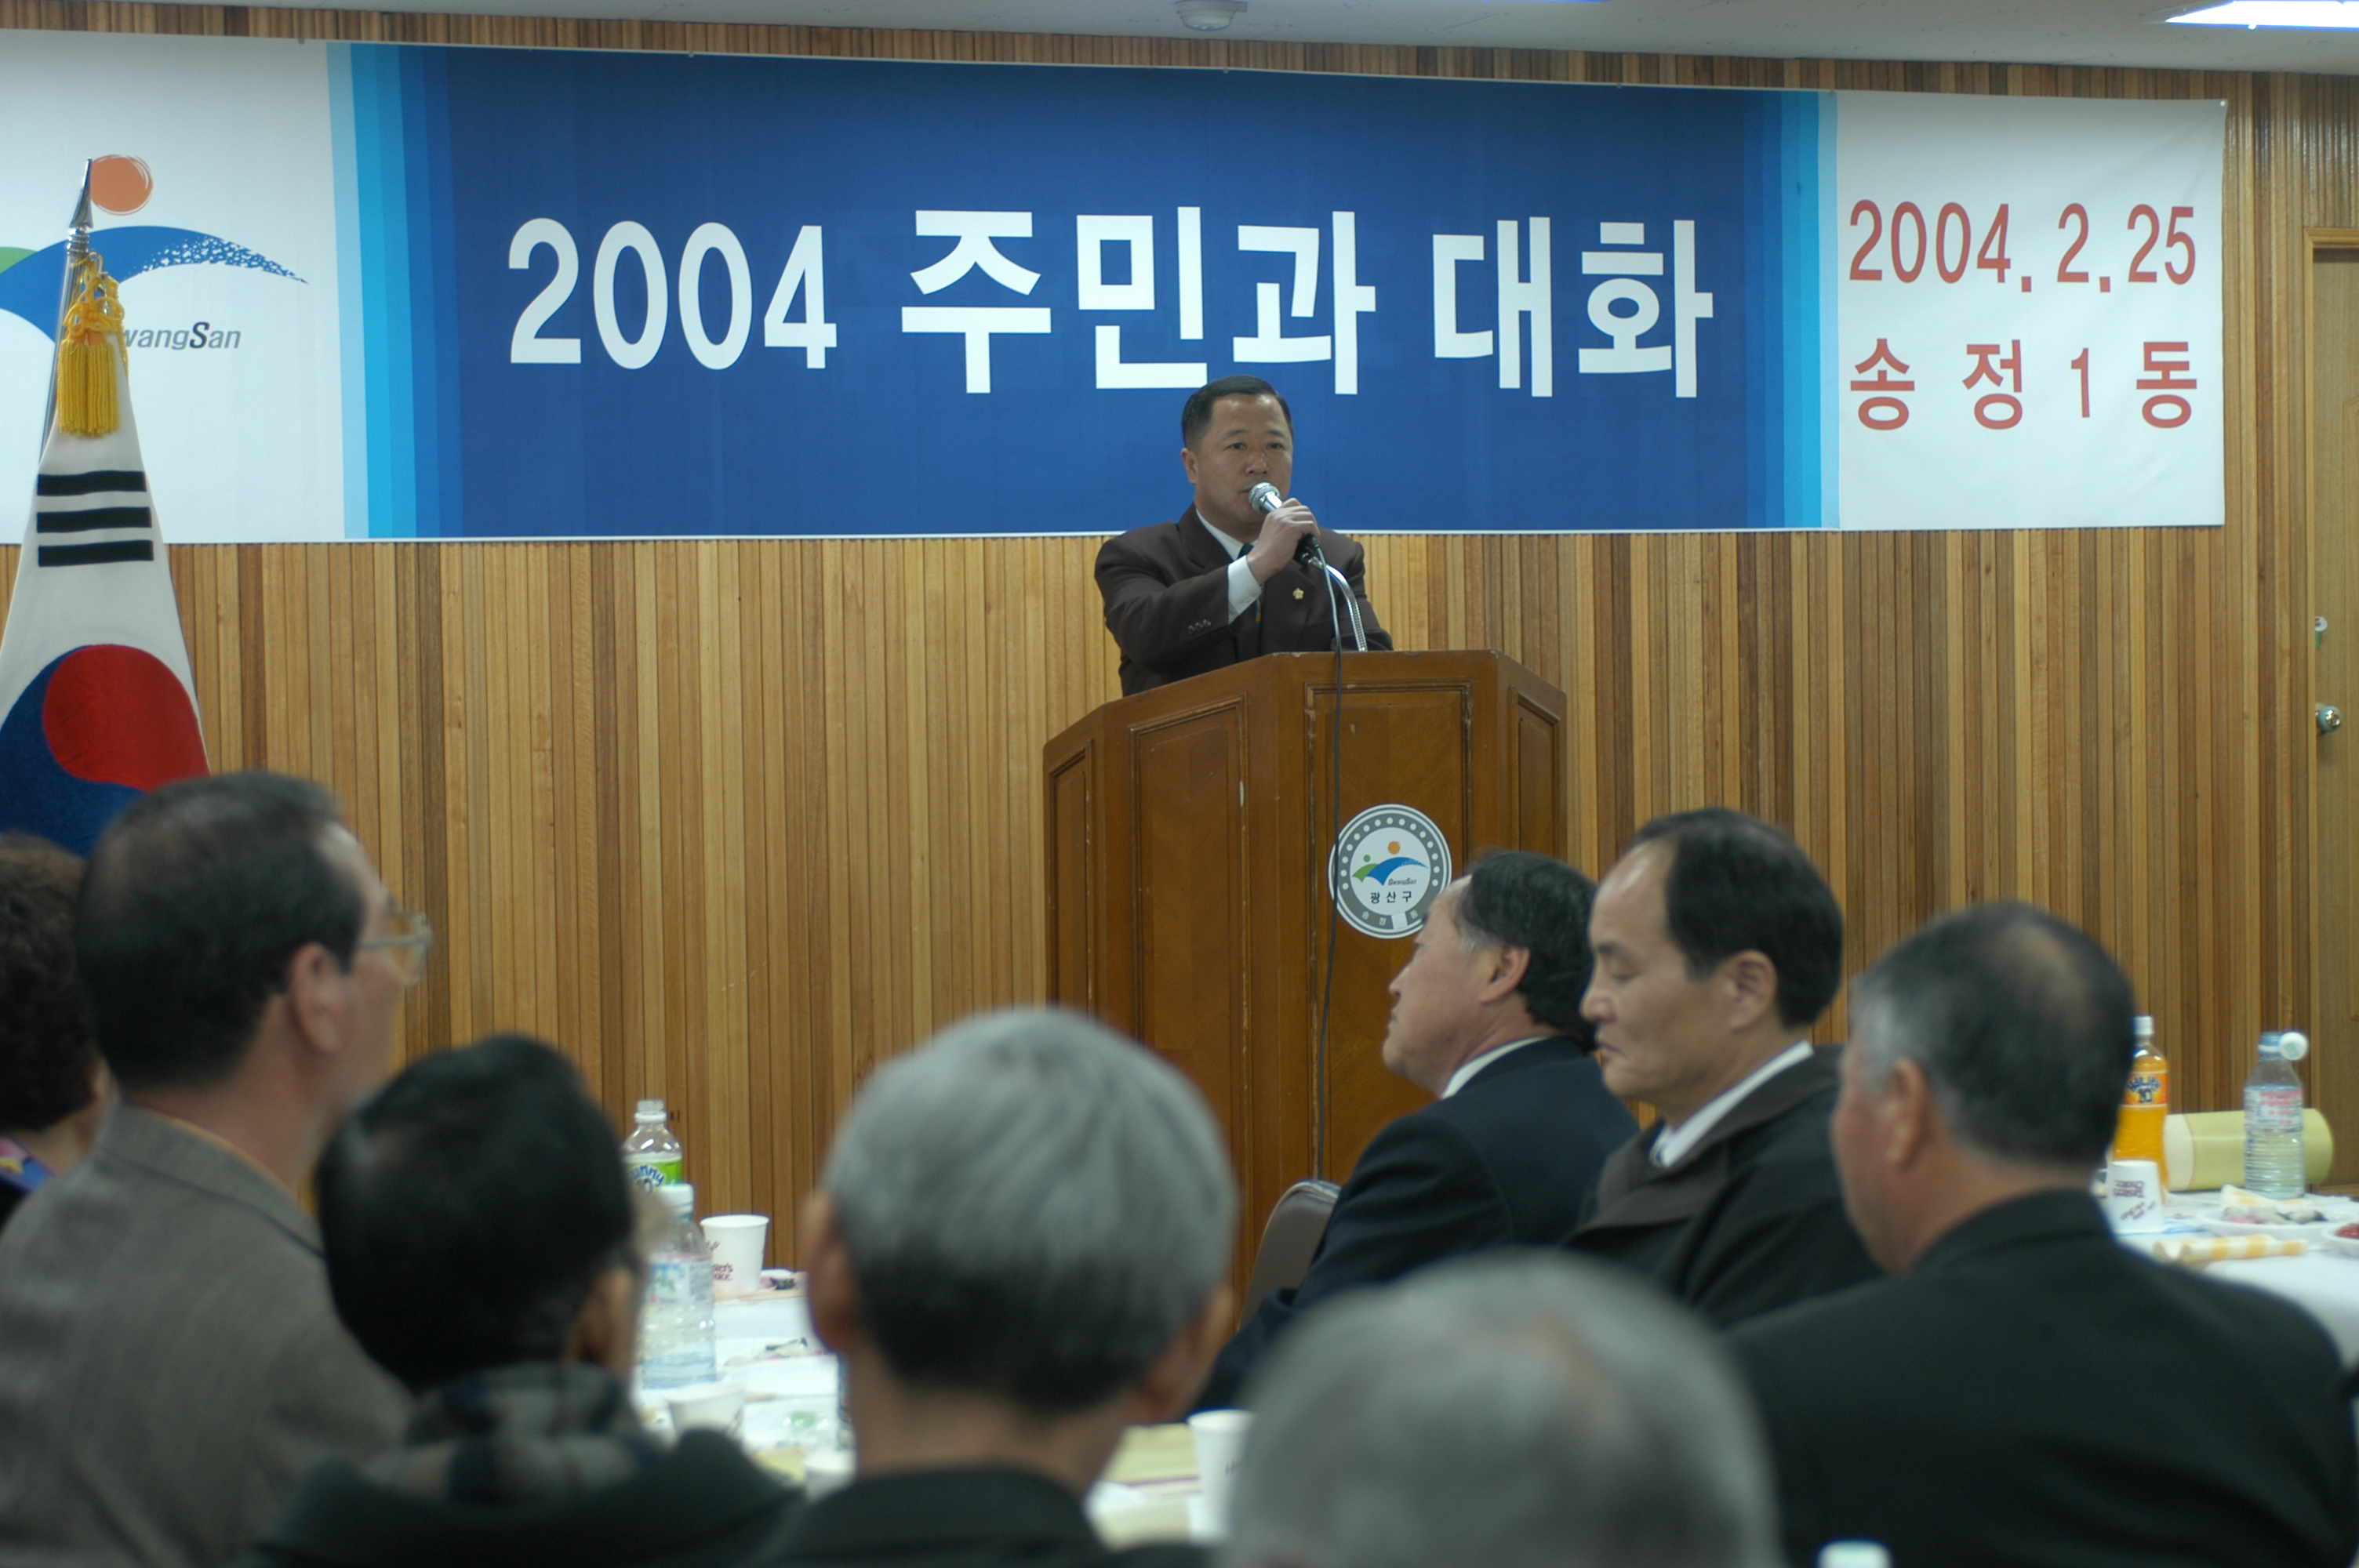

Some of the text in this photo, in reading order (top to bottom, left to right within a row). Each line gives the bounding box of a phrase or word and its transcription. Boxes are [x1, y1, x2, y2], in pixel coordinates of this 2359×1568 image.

[508, 205, 1714, 398] 2004 주민과 대화
[123, 321, 242, 350] wangSan
[1370, 891, 1412, 904] 광산구
